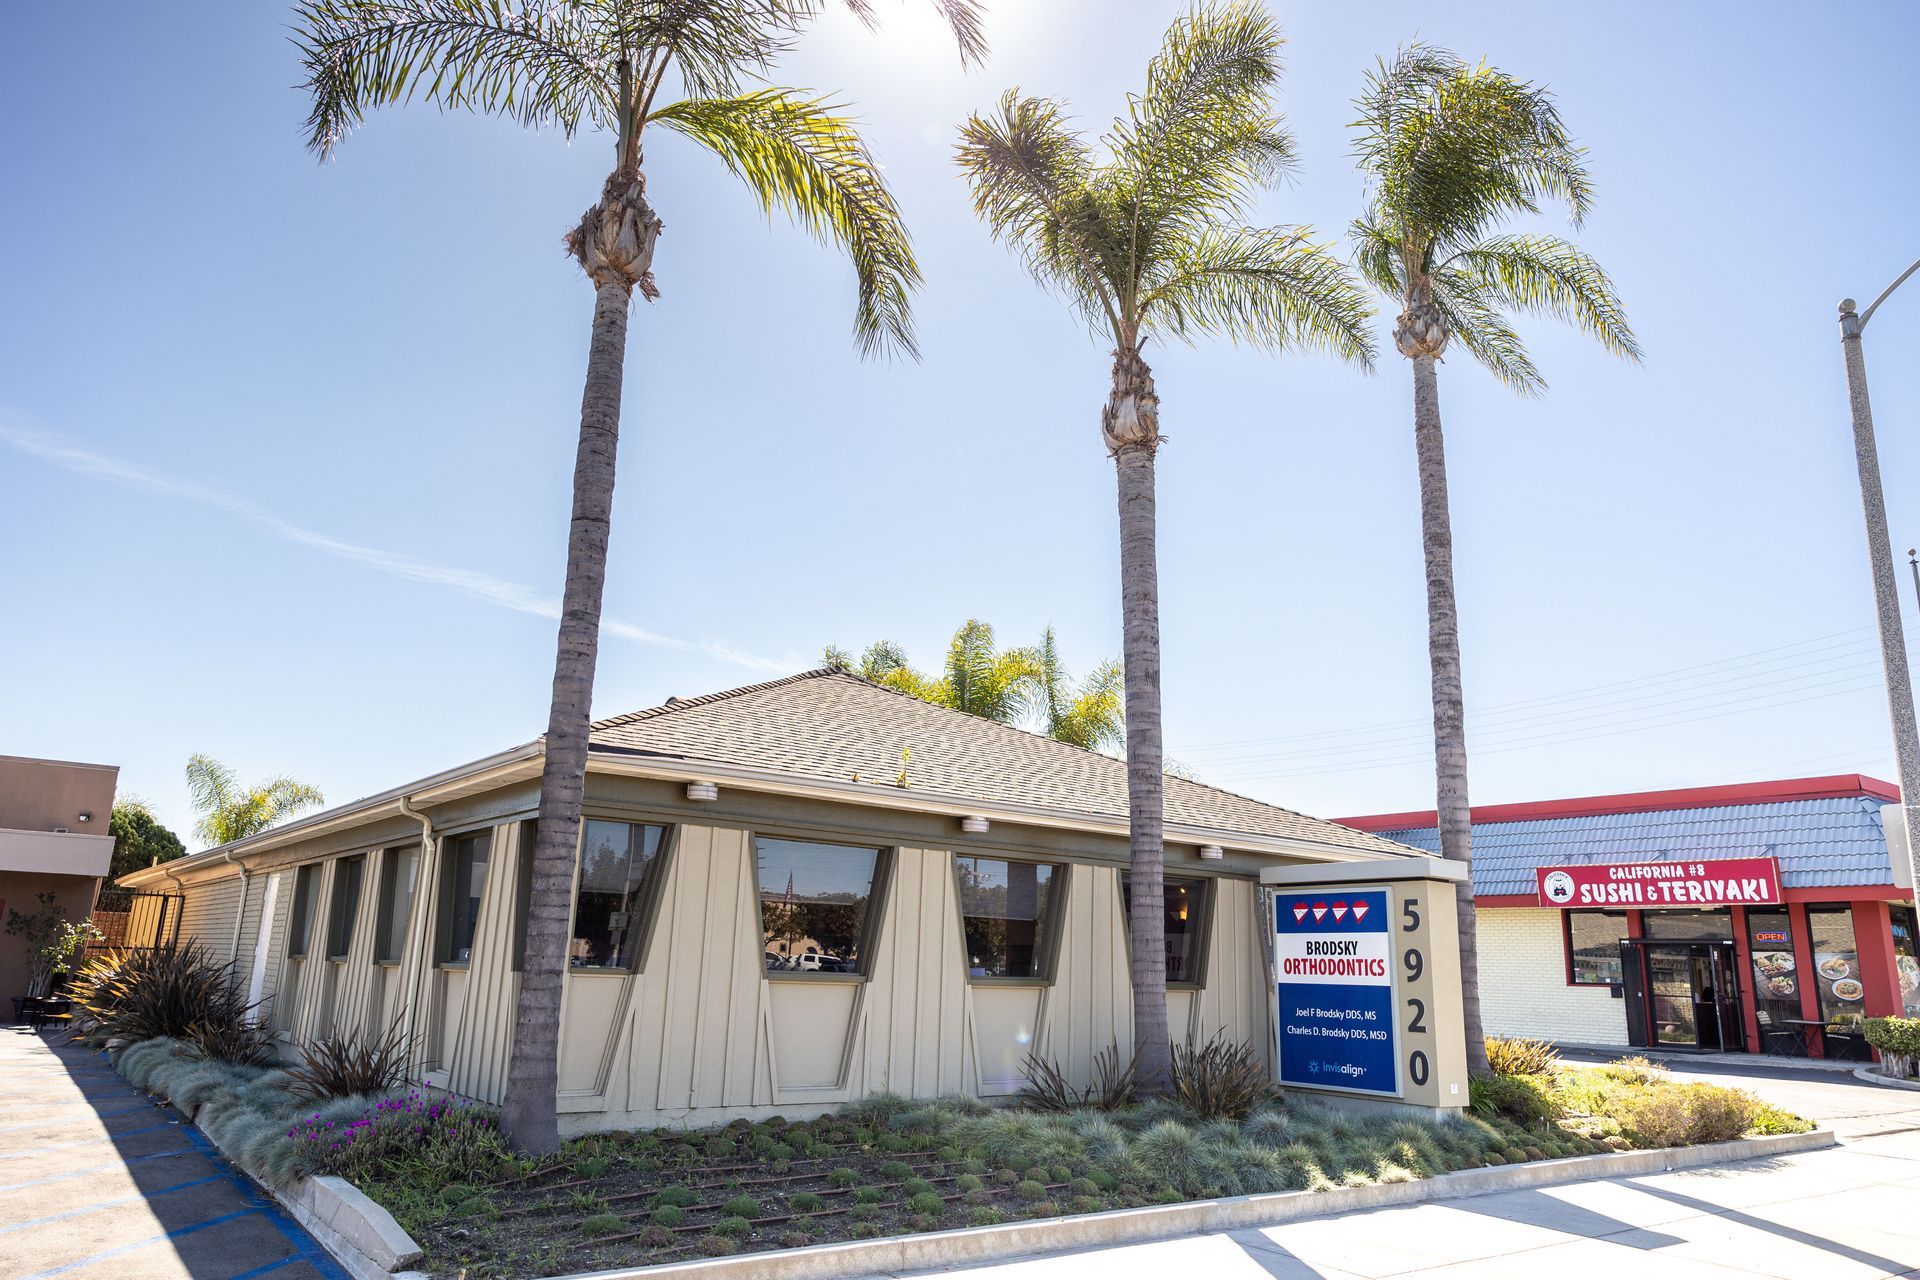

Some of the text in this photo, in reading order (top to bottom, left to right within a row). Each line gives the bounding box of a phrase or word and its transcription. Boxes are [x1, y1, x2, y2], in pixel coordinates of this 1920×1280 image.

[1609, 864, 1705, 880] CALIFORNIA #8
[1580, 878, 1769, 904] SUSHI & TERIYAKI
[1756, 933, 1785, 941] OPEN
[1306, 940, 1358, 956] BRODSKY
[1283, 958, 1385, 977] ORTHODONTICS
[1403, 898, 1430, 1087] 5920
[1295, 1007, 1377, 1021] Joel F Brodsky DDS, MS
[1287, 1025, 1387, 1041] Charles D. Brodsky DDS, MSD
